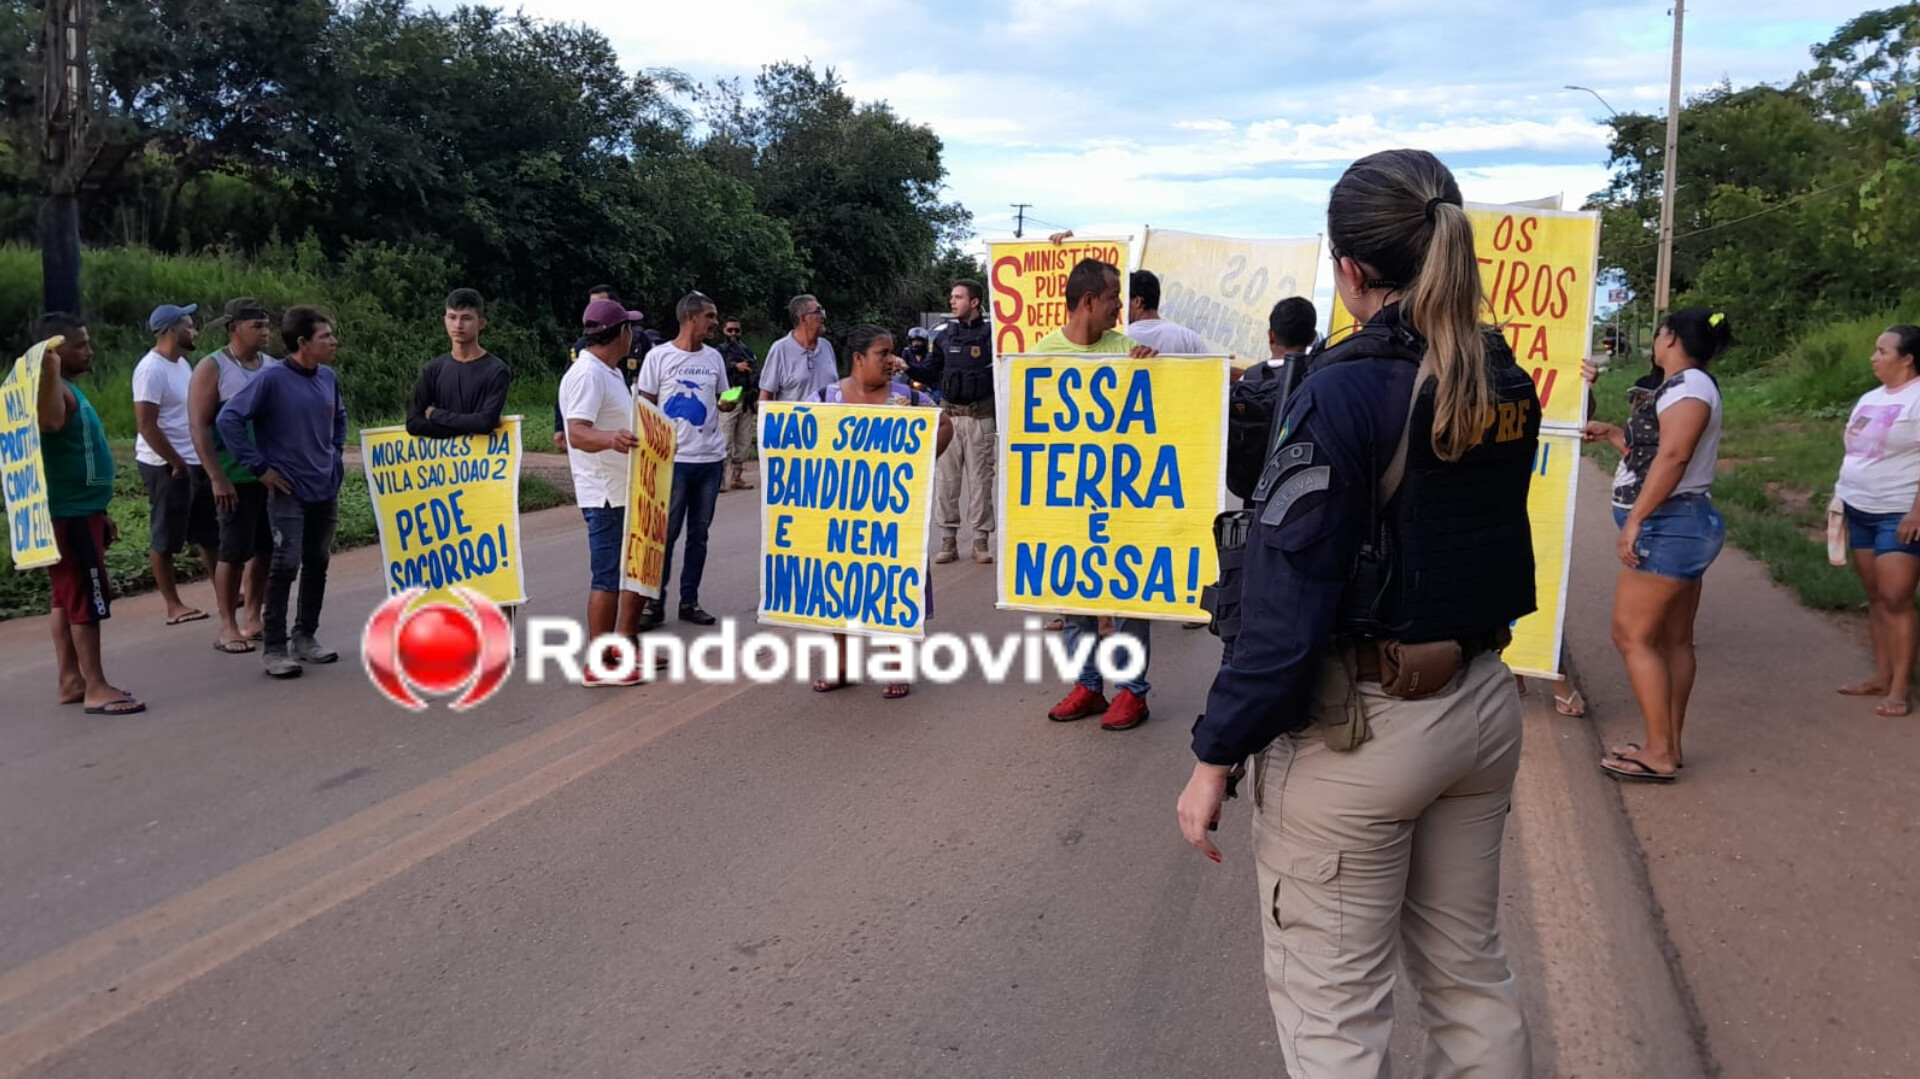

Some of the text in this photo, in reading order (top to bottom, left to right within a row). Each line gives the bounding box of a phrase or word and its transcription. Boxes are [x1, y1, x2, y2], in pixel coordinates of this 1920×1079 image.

[1493, 215, 1537, 253] OS
[1023, 366, 1157, 434] ESSA
[1465, 401, 1531, 446] PRF
[371, 430, 511, 469] MORADORES DA
[763, 406, 927, 455] NÃO SOMOS
[373, 457, 508, 496] VILA SAO JOAO 2
[766, 456, 914, 515] BANDIDOS
[1010, 443, 1185, 509] TERRA
[395, 489, 473, 552] PEDE
[775, 515, 899, 559] E NEM
[390, 524, 510, 596] SOCORRO!
[1014, 542, 1201, 604] NOSSA!
[764, 554, 920, 628] INVASORES
